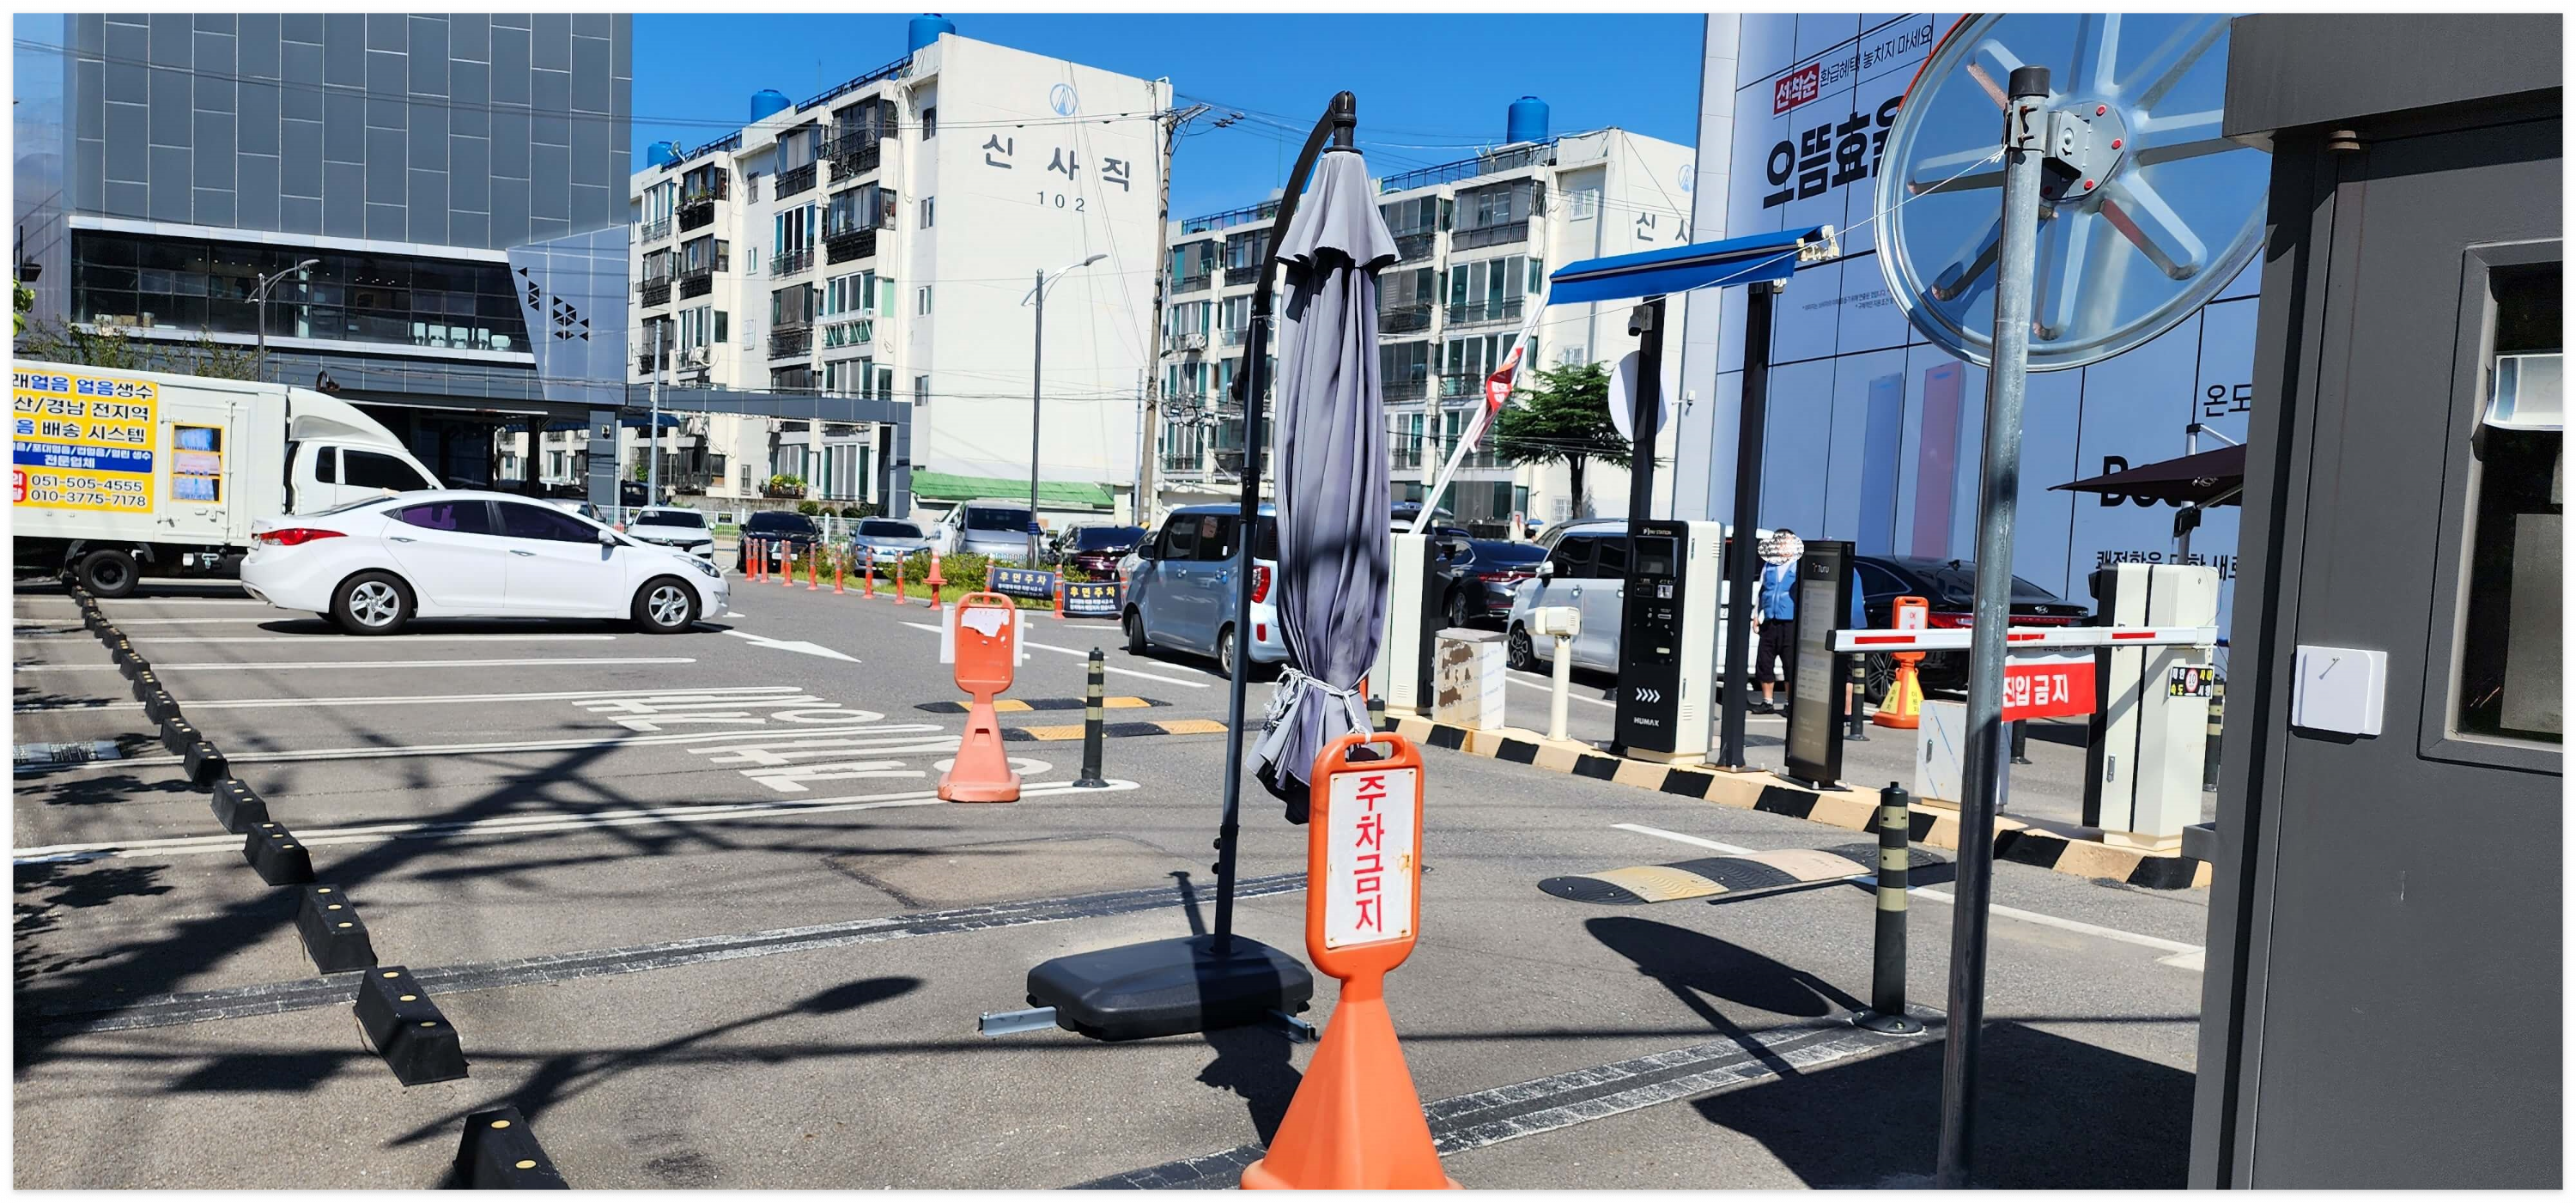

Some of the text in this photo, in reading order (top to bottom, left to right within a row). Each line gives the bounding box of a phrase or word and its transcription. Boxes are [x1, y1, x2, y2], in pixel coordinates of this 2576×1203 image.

[1776, 24, 1933, 110] 선착순 환급혜택 놓치지 마세요
[1036, 191, 1085, 213] 102
[76, 379, 154, 399] 얼음생수
[92, 402, 149, 422] 전지역
[42, 421, 81, 439] 배송
[88, 425, 144, 443] 시스템
[31, 475, 143, 492] 051-505-4555
[31, 489, 146, 507] 010-3775-7178
[1634, 716, 1660, 727] HUMAX
[1353, 775, 1387, 933] 주차금지
